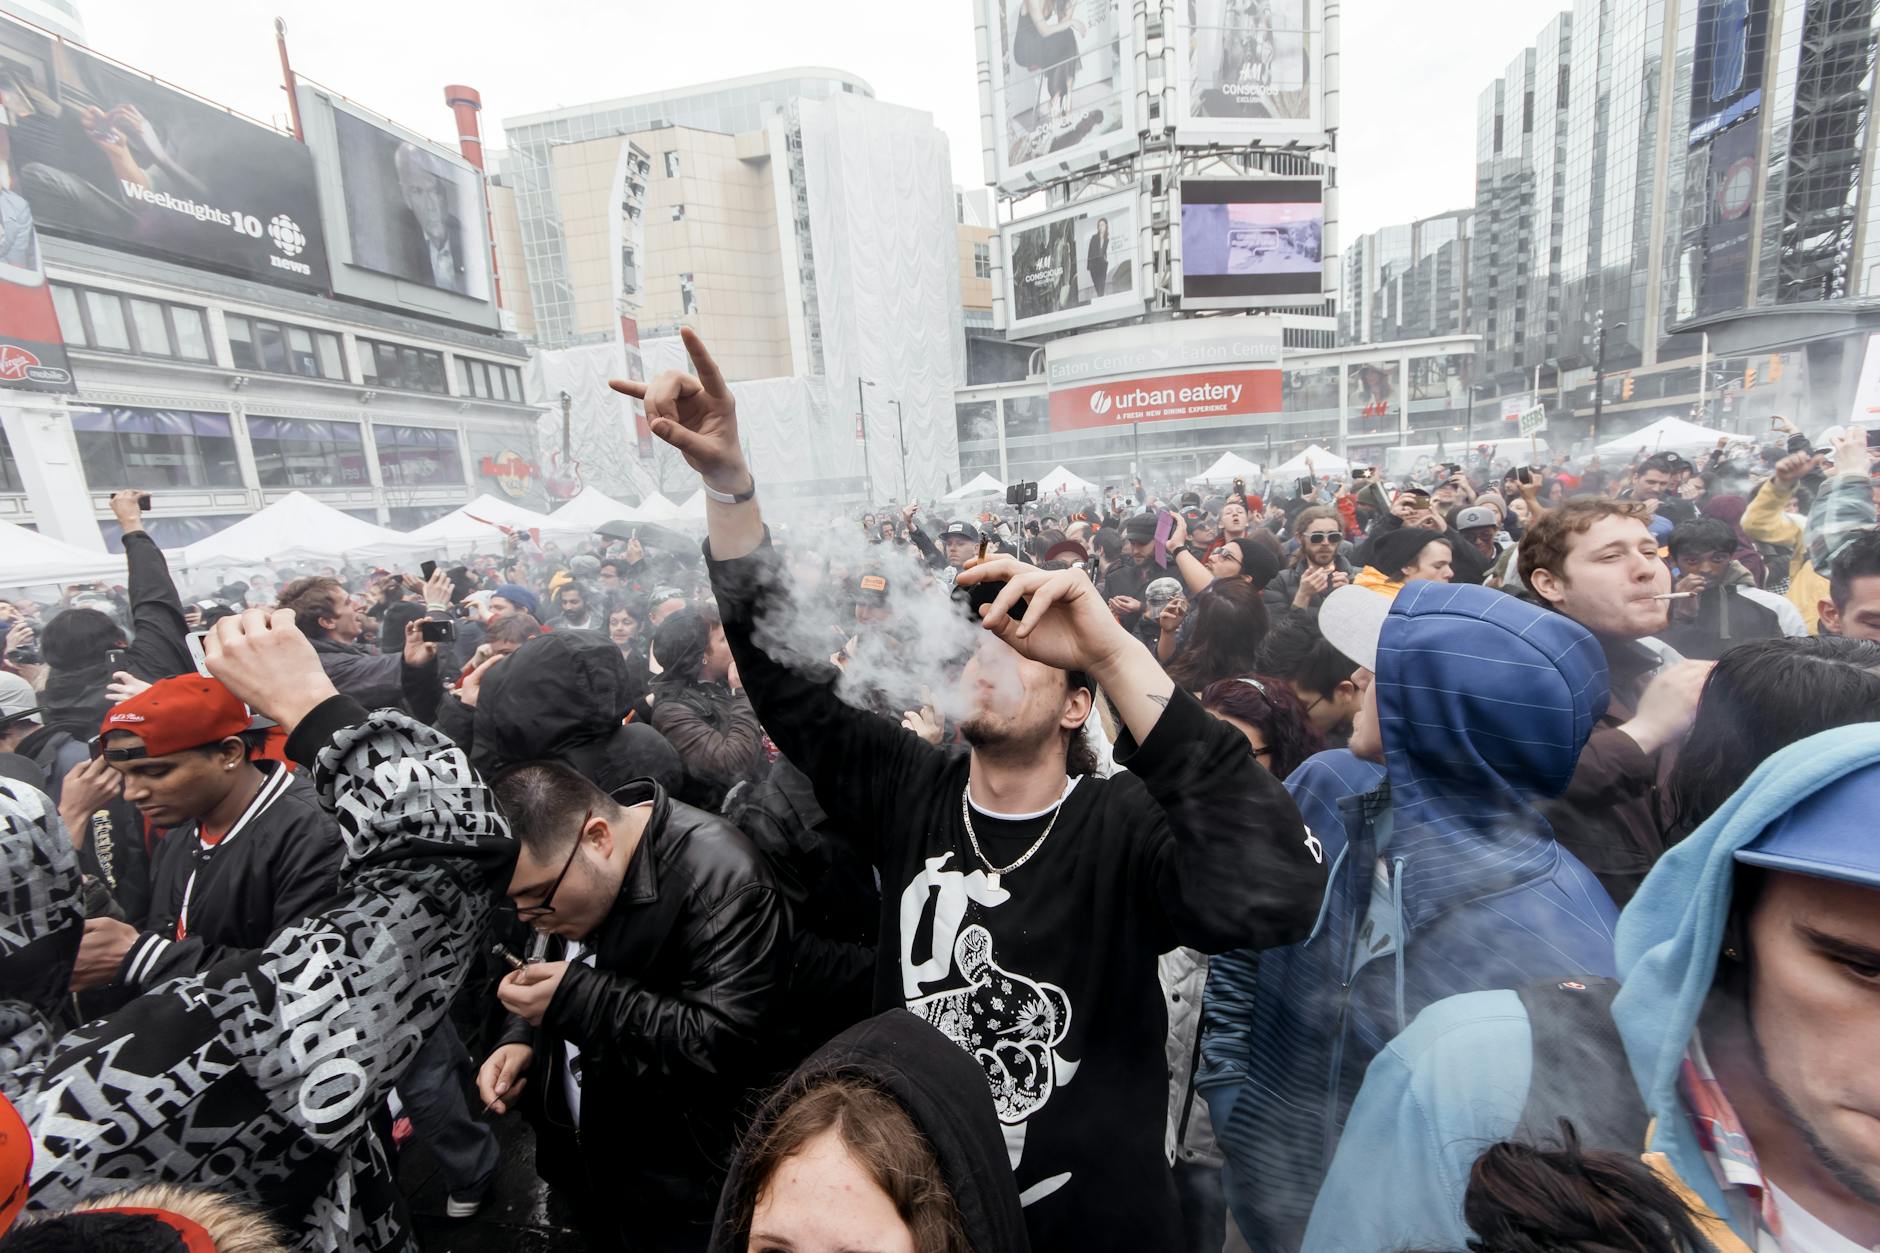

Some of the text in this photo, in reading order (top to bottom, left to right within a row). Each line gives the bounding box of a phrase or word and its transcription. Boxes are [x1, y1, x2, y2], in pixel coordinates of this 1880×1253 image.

[1222, 84, 1279, 96] CONSCIOUS
[121, 179, 263, 238] Weeknights 10
[270, 254, 311, 275] news
[1025, 266, 1064, 283] CONSCIOUS
[1051, 358, 1089, 379] Eaton
[1093, 352, 1145, 371] Centre
[1232, 341, 1277, 357] Centre
[1116, 382, 1243, 409] urban eatery
[1123, 411, 1144, 420] FRESH
[1146, 410, 1161, 418] NEW
[1163, 407, 1186, 416] DINING
[1188, 404, 1228, 414] EXPERIENCE
